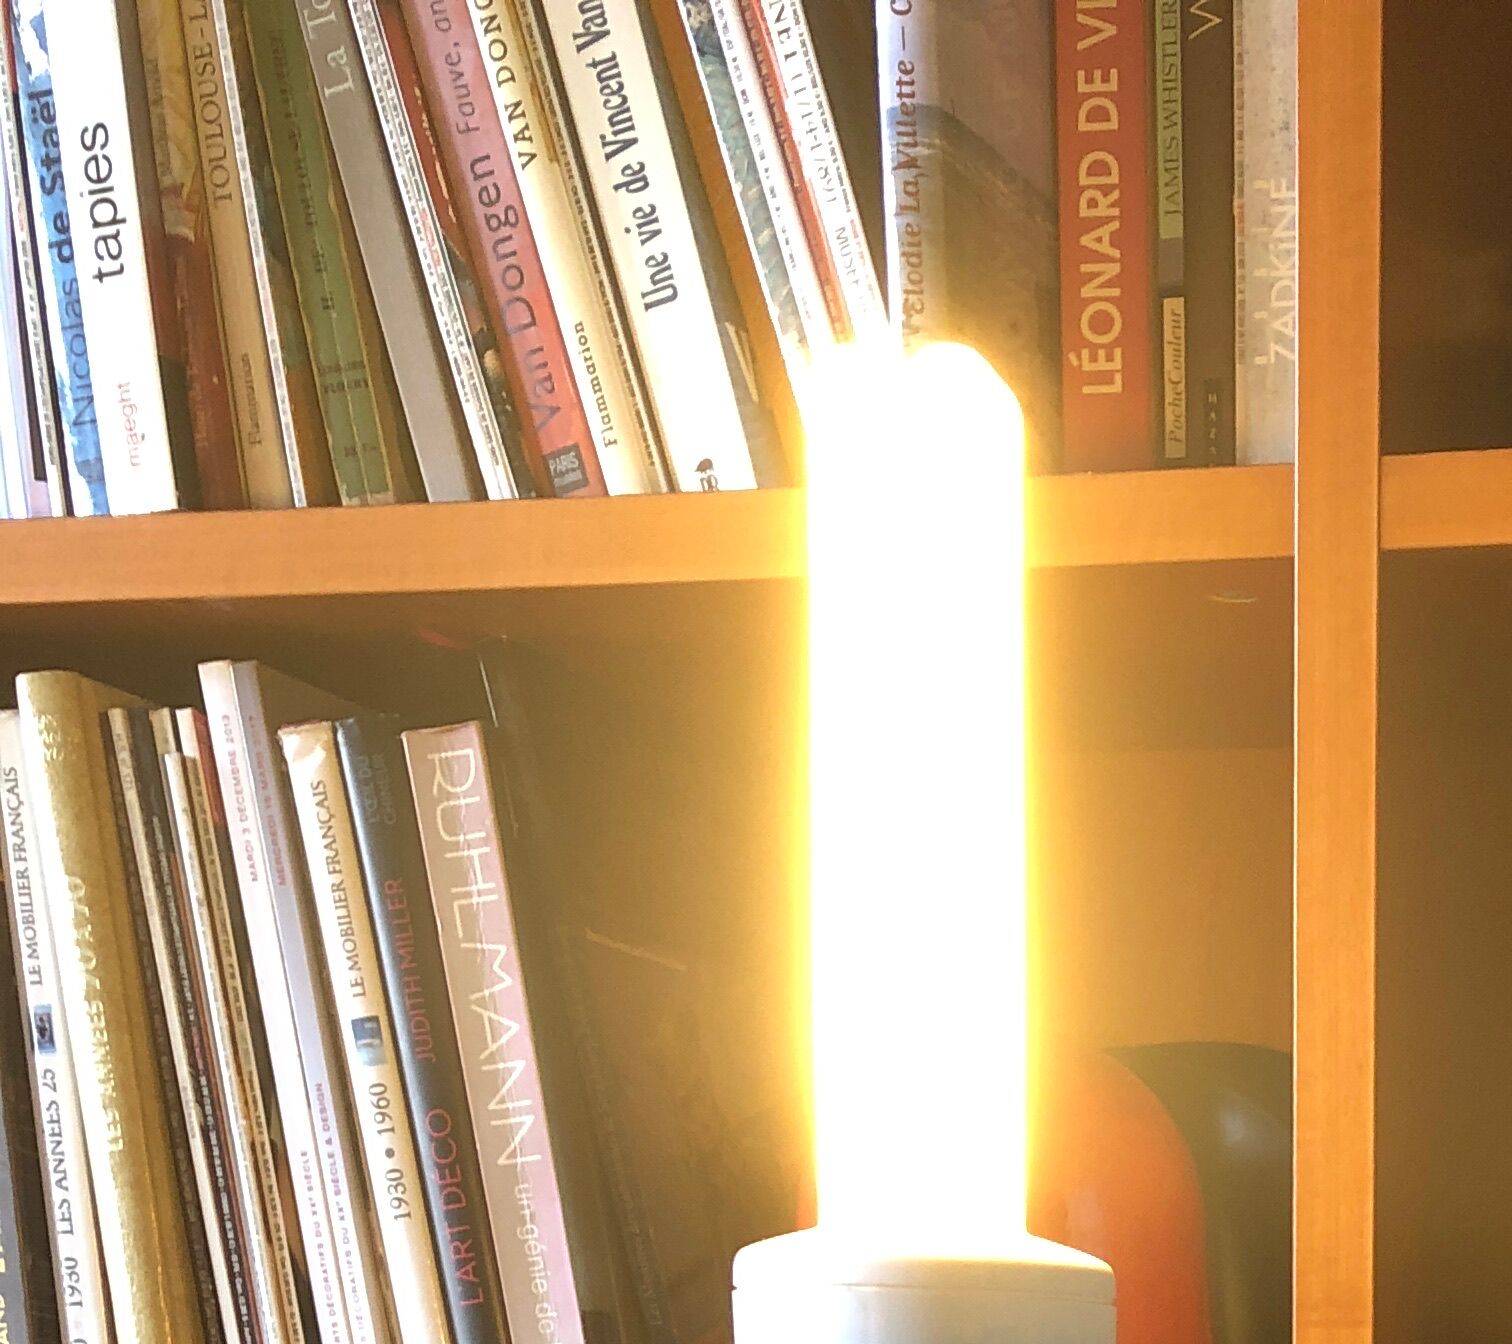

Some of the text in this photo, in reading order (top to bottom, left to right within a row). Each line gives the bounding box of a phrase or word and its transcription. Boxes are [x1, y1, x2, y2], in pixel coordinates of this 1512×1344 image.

[323, 45, 355, 98] La
[504, 99, 538, 172] VAN
[79, 121, 127, 284] tapies
[468, 152, 537, 337] Dongen
[585, 51, 679, 313] Une vie de Vincent
[1068, 67, 1123, 395] LÉONARD DE
[1164, 136, 1183, 217] JAMES
[27, 87, 99, 428] Nicolas de Staël
[117, 380, 142, 468] maeght
[523, 345, 562, 433] Van
[574, 319, 619, 448] Flammarion
[1168, 307, 1185, 444] PocheCouleur
[1, 767, 42, 985] LE MOBILIER FRANÇAIS
[311, 780, 366, 998] LE MOBILIER FRANÇAIS
[384, 879, 436, 1062] JUDITH MILLER
[427, 747, 543, 1166] RUHLMANN
[368, 1082, 413, 1222] 1930 1960
[518, 1222, 548, 1293] génie
